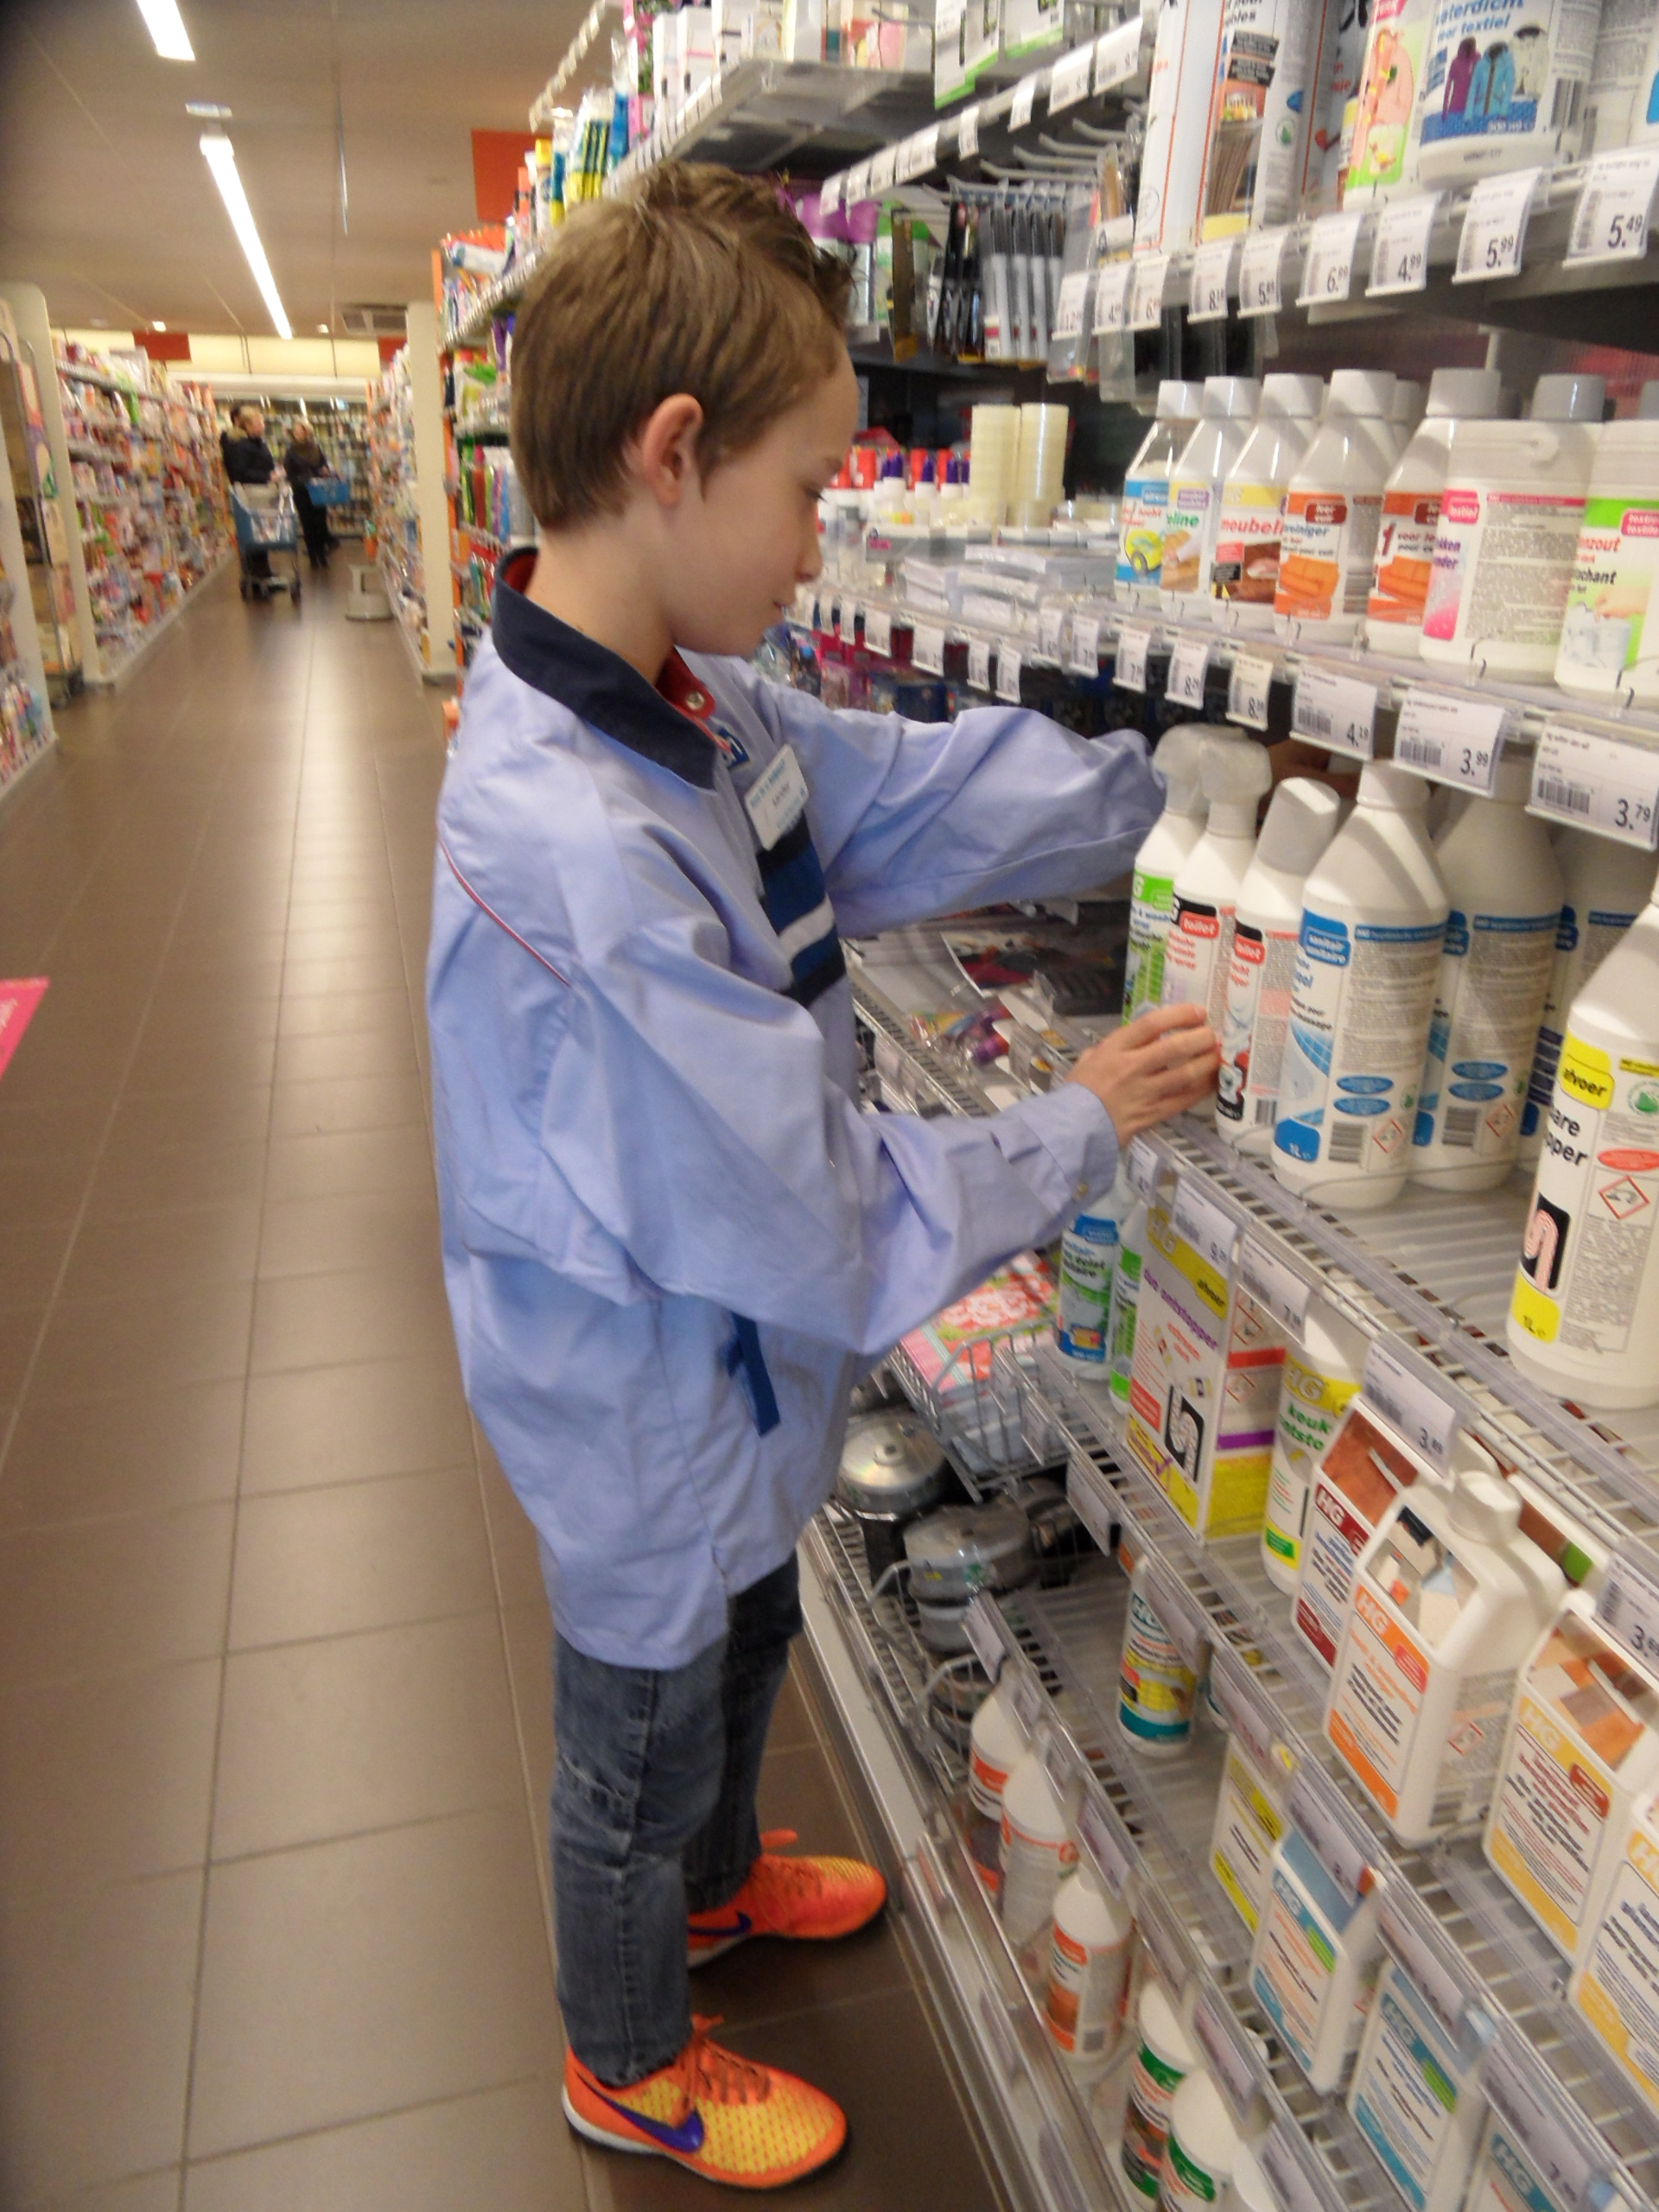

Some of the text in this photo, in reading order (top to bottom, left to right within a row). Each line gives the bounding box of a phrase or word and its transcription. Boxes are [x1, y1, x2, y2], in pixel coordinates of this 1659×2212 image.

[1608, 214, 1643, 249] 5.49
[1485, 235, 1515, 269] 5.99
[1382, 521, 1396, 556] 1
[1460, 747, 1490, 777] 3.99
[1614, 798, 1651, 831] 3.79
[1316, 1488, 1345, 1527] HG
[1357, 1592, 1390, 1634] HG
[1522, 1703, 1561, 1751] HG
